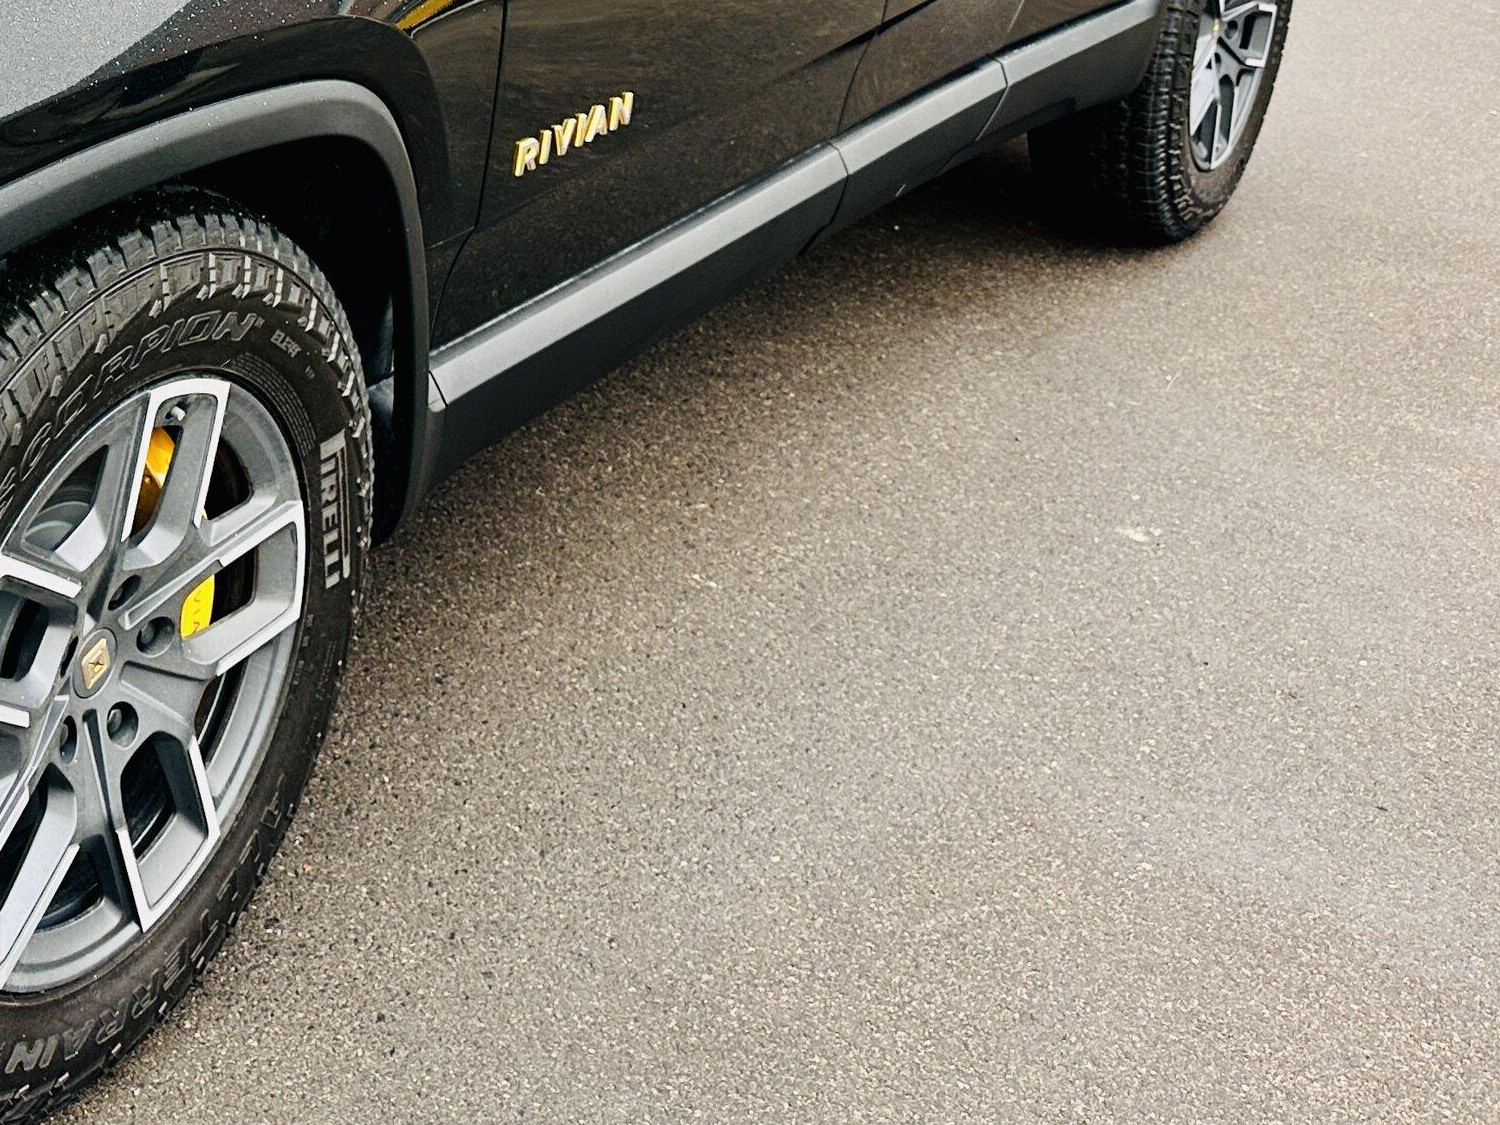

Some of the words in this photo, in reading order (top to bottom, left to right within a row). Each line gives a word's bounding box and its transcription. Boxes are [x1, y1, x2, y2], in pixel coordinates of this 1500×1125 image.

[514, 91, 634, 177] RIVIAN
[319, 428, 350, 590] PIRELLI
[5, 908, 219, 1074] TERRAIN
